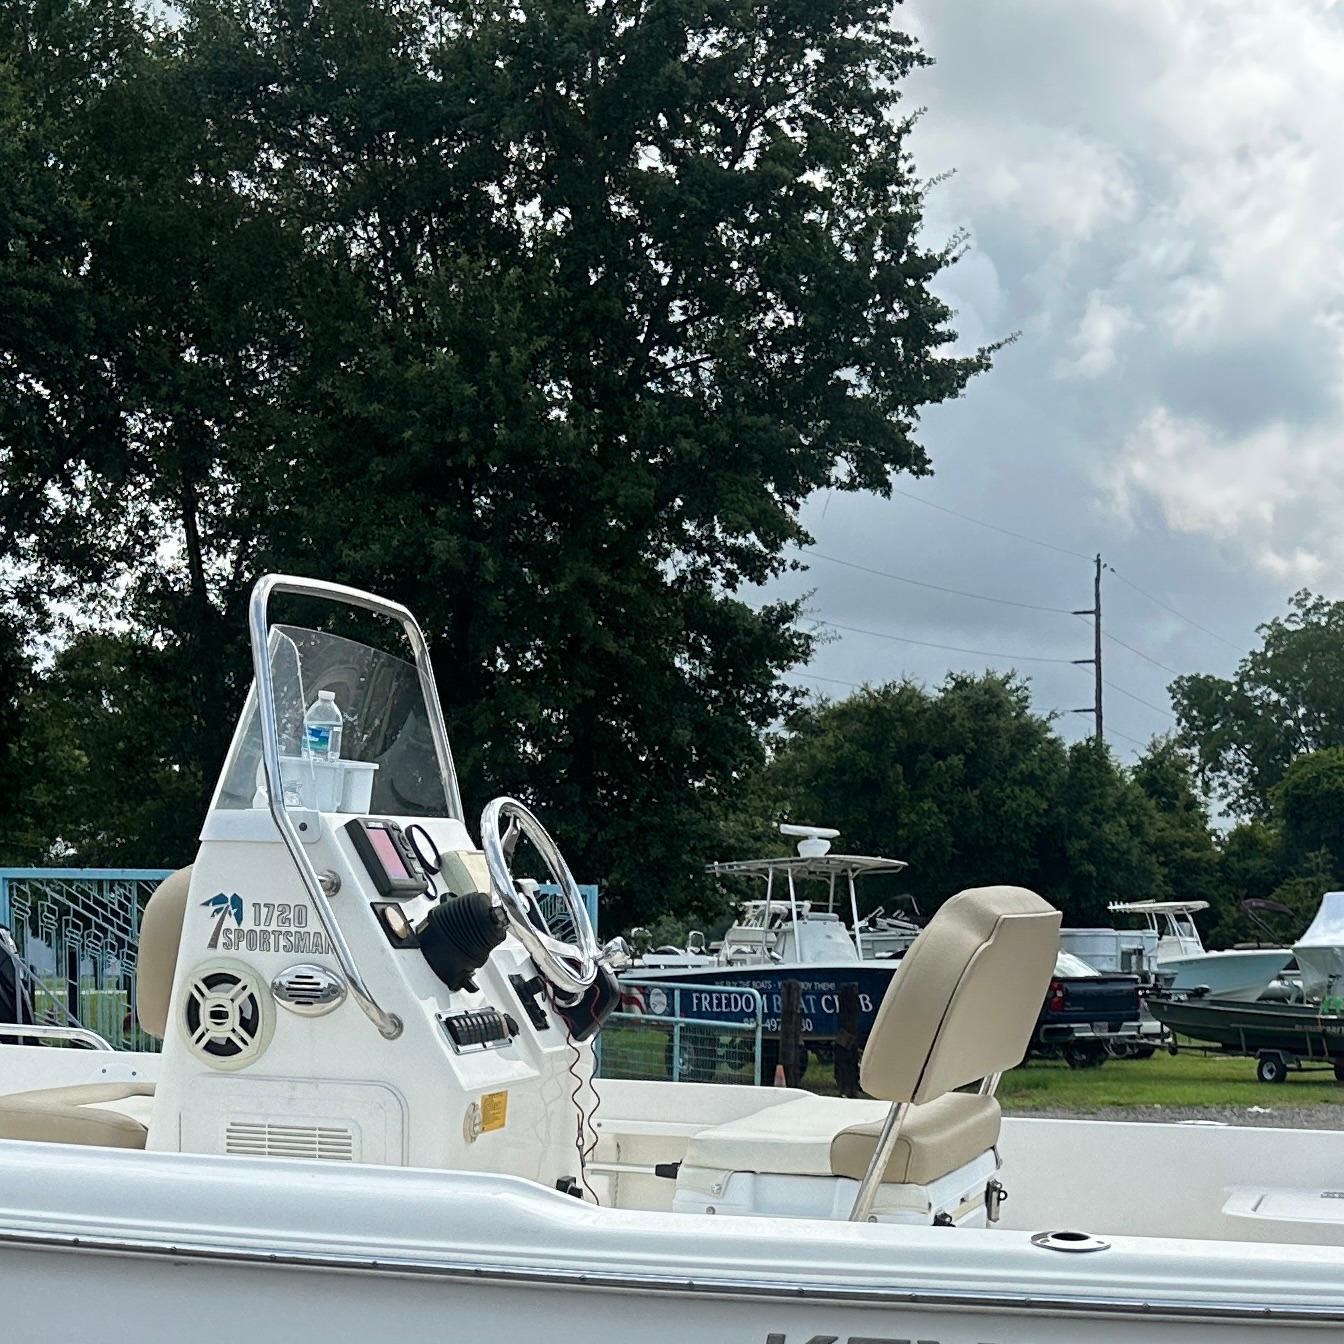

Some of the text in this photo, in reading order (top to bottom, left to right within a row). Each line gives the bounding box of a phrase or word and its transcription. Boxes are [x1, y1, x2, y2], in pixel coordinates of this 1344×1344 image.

[252, 903, 307, 928] 1720
[773, 993, 817, 1014] BAT
[821, 993, 874, 1014] CB
